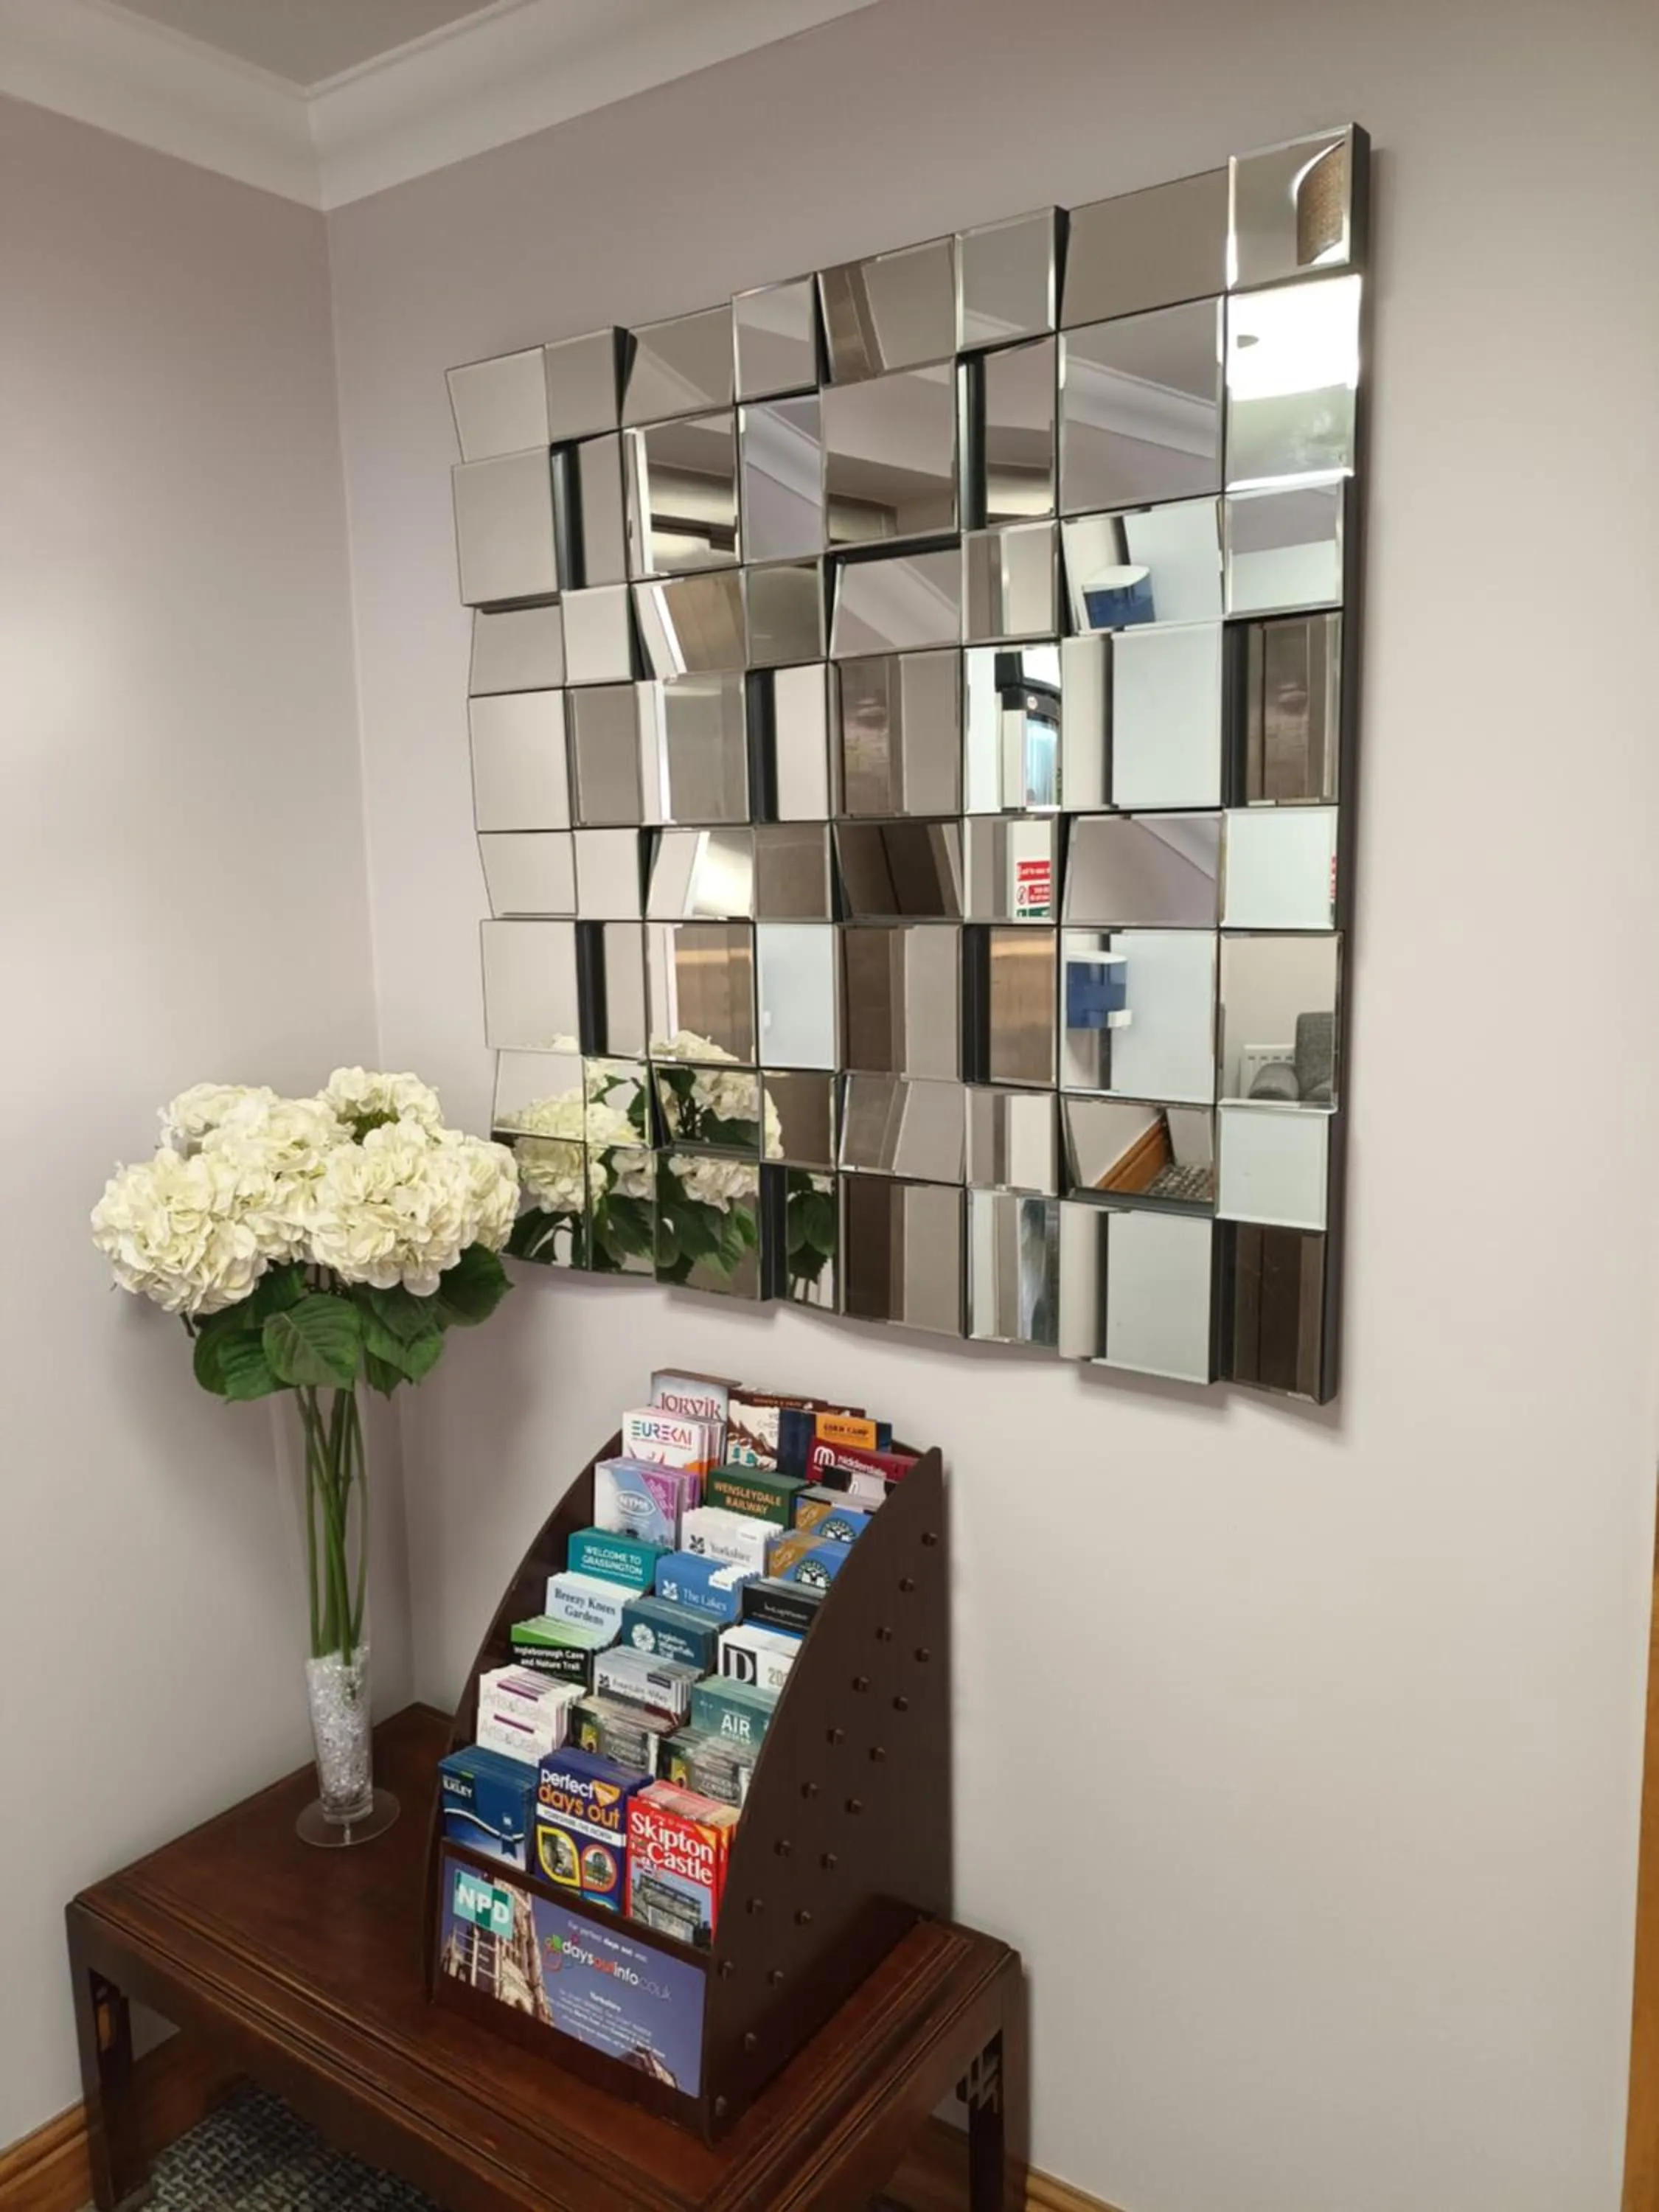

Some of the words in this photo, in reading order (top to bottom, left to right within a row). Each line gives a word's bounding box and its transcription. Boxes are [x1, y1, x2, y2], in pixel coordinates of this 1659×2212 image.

[713, 1481, 783, 1506] WENSLEYDALE
[725, 1496, 768, 1515] RAILWAY
[581, 1554, 643, 1575] GRASSINGTON
[584, 1545, 627, 1562] WELCOME
[629, 1555, 641, 1565] TO
[554, 1587, 585, 1608] Breezy
[588, 1598, 616, 1615] Knees
[683, 1587, 700, 1604] The
[700, 1594, 727, 1612] Lakes
[565, 1604, 605, 1627] Gardens
[521, 1658, 535, 1666] and
[535, 1658, 561, 1669] Nature
[565, 1649, 584, 1660] Cave
[721, 1714, 751, 1739] AIR
[540, 1769, 595, 1799] perfect
[538, 1784, 584, 1816] days
[587, 1804, 620, 1829] out
[630, 1811, 714, 1865] Skipton
[647, 1842, 713, 1885] Castle
[457, 1882, 509, 1924] NPD
